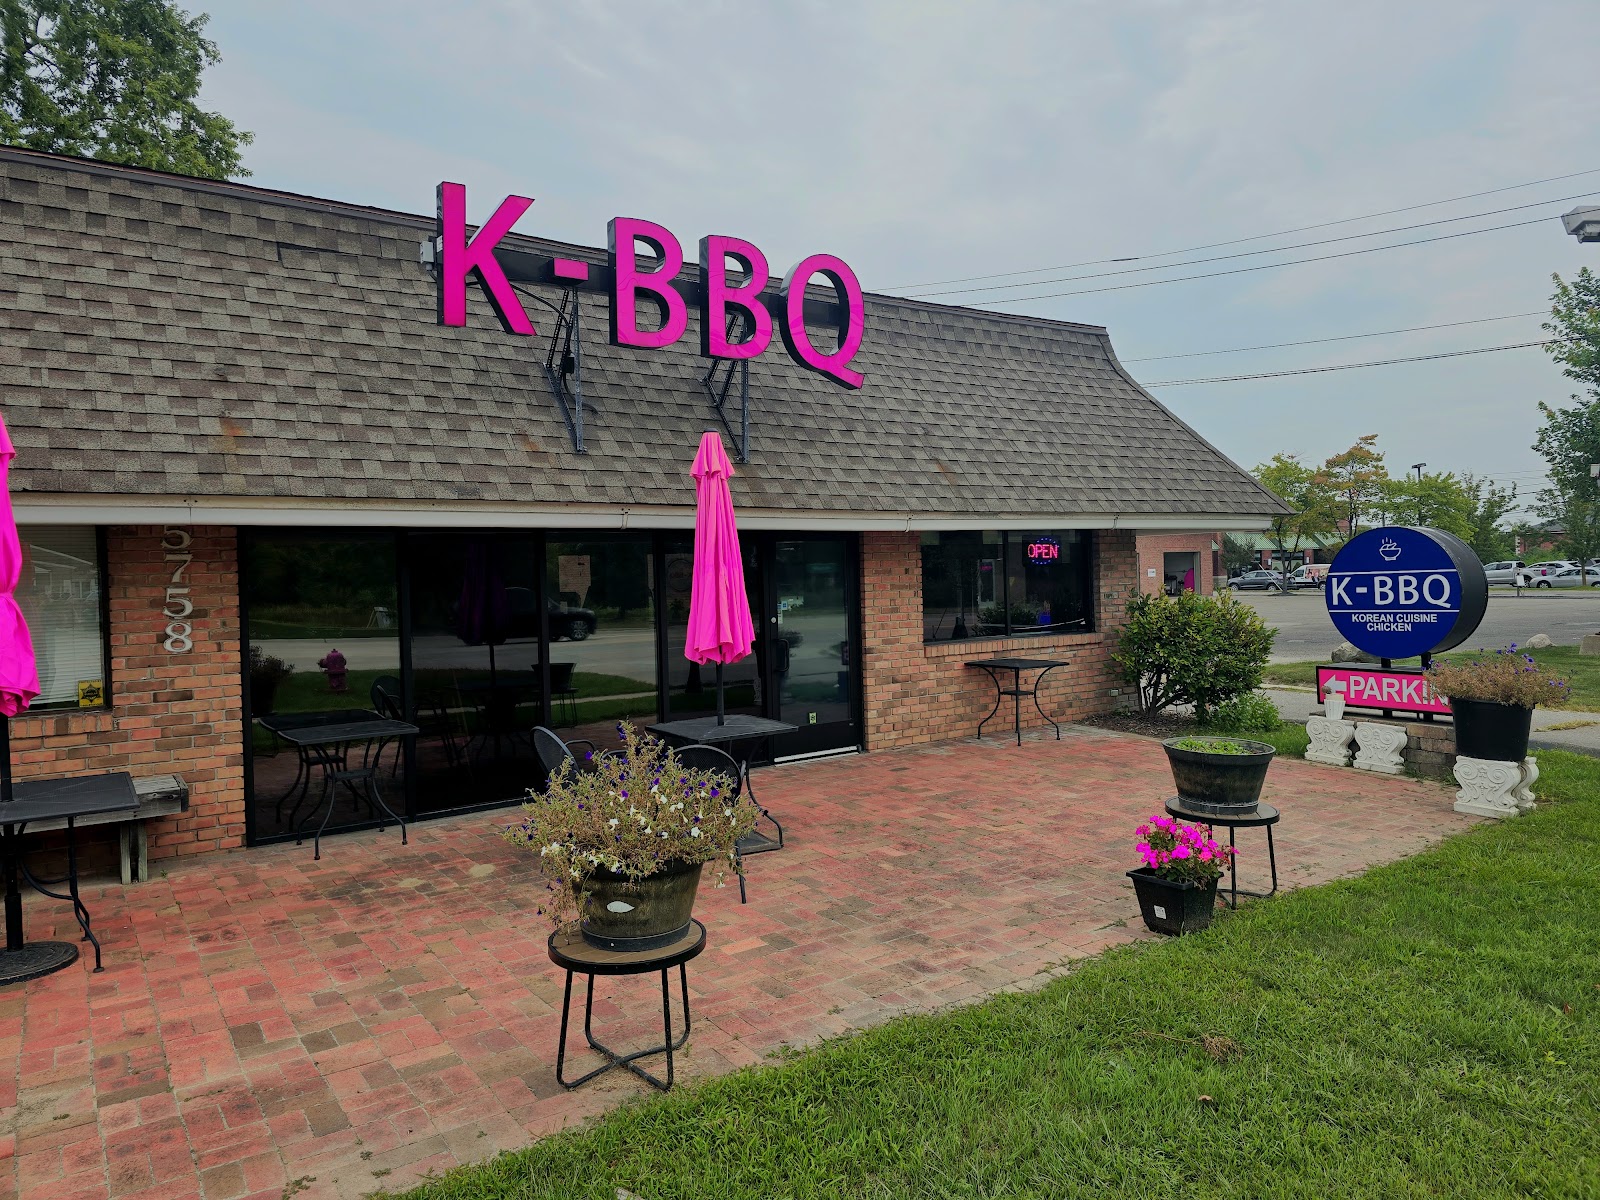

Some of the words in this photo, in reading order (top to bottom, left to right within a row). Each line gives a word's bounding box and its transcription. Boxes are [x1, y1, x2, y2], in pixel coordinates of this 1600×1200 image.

[437, 181, 865, 389] K-BBQ
[1027, 543, 1059, 559] OPEN
[160, 524, 195, 653] 5758
[1331, 574, 1452, 609] K-BBQ
[1351, 613, 1394, 623] KOREAN
[1396, 613, 1438, 623] CUISINE
[1366, 622, 1412, 632] CHICKEN
